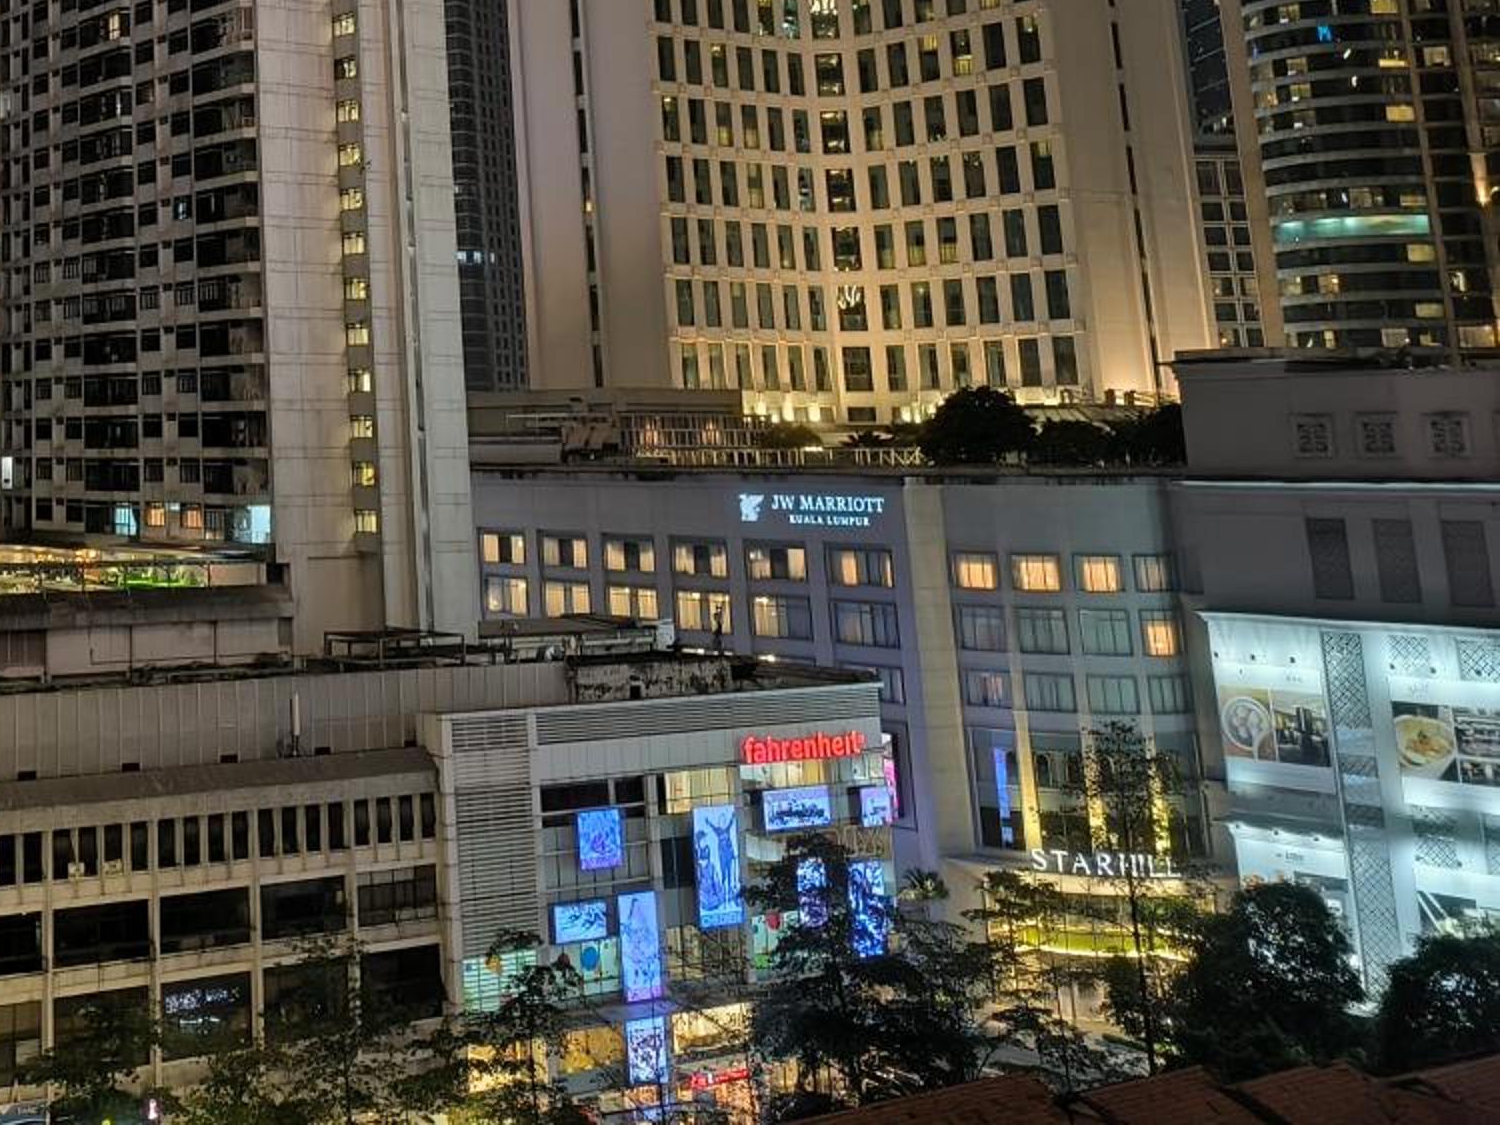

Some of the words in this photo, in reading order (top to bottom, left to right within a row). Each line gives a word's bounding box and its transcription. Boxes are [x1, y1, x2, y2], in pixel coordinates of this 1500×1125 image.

[771, 494, 795, 511] JW
[800, 494, 885, 514] MARRIOTT
[789, 514, 823, 525] KUALA
[827, 516, 871, 527] LUMPUR
[744, 730, 861, 765] fahrenheit
[1031, 847, 1182, 878] STARHILL
